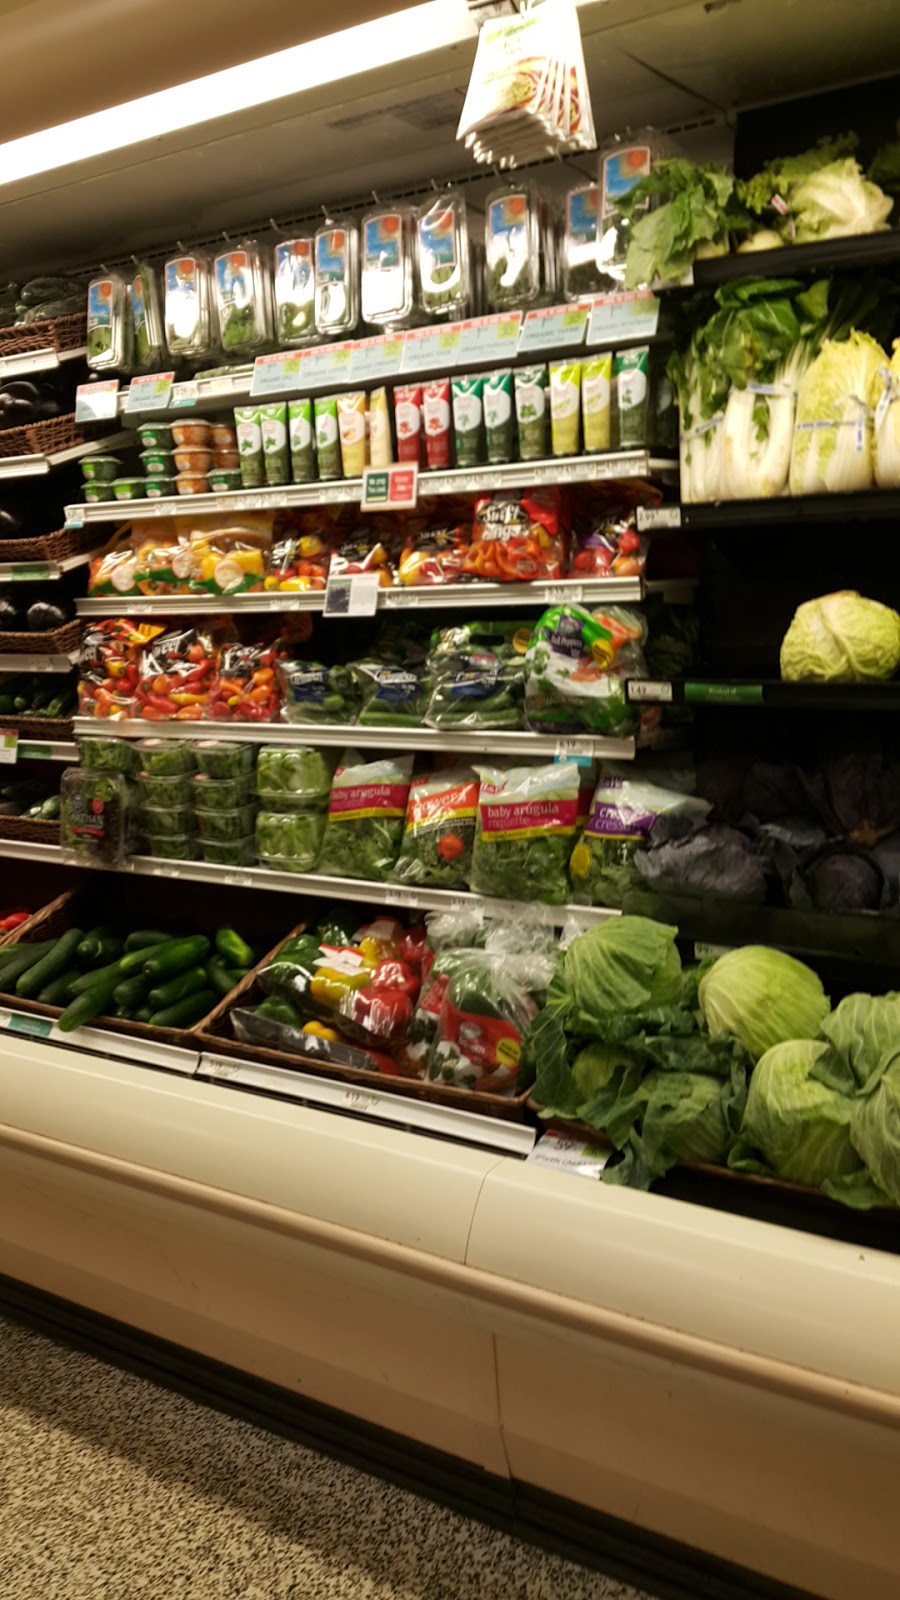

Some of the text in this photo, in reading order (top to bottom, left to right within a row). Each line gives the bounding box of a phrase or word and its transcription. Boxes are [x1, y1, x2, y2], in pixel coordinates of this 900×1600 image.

[349, 785, 391, 800] arugula
[487, 801, 560, 818] baby arugula
